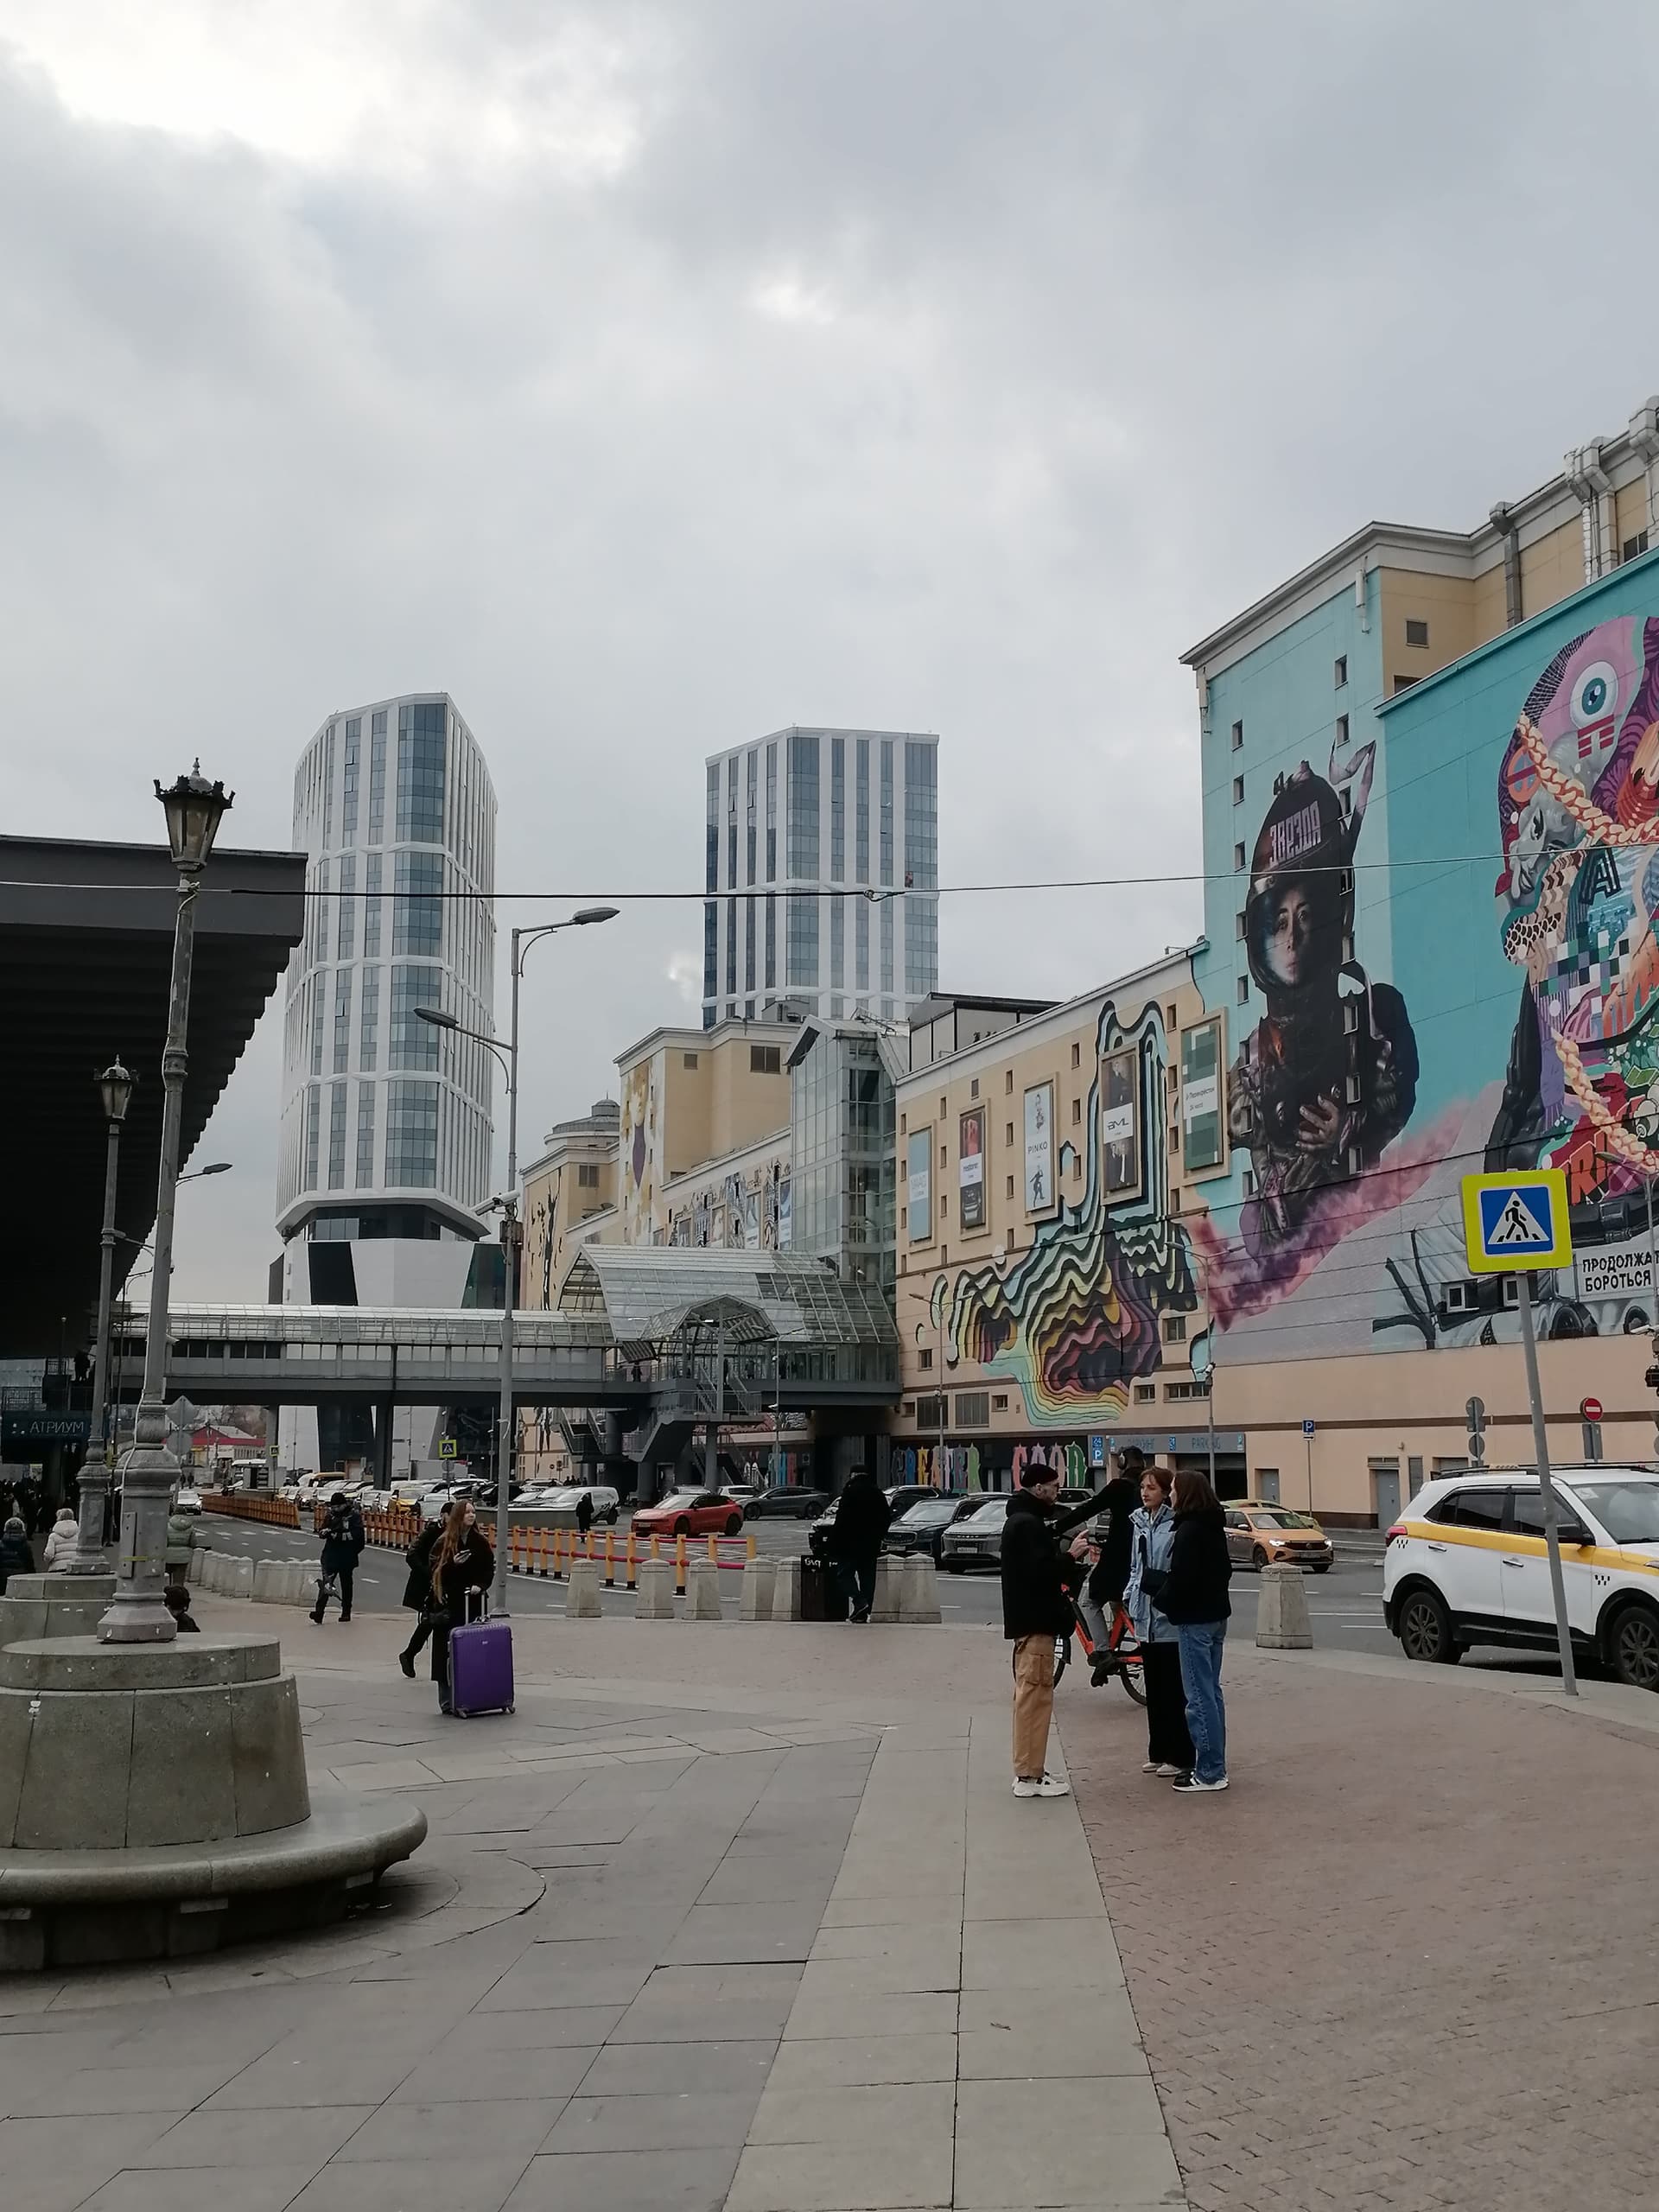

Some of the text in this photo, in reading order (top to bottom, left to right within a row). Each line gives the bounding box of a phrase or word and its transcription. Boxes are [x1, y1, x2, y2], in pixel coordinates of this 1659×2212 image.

[1027, 1141, 1048, 1154] PINKO
[1585, 1269, 1651, 1292] БОРОТЬСЯ
[29, 1421, 84, 1433] АТРИУМ
[1192, 1437, 1221, 1450] PARKNG
